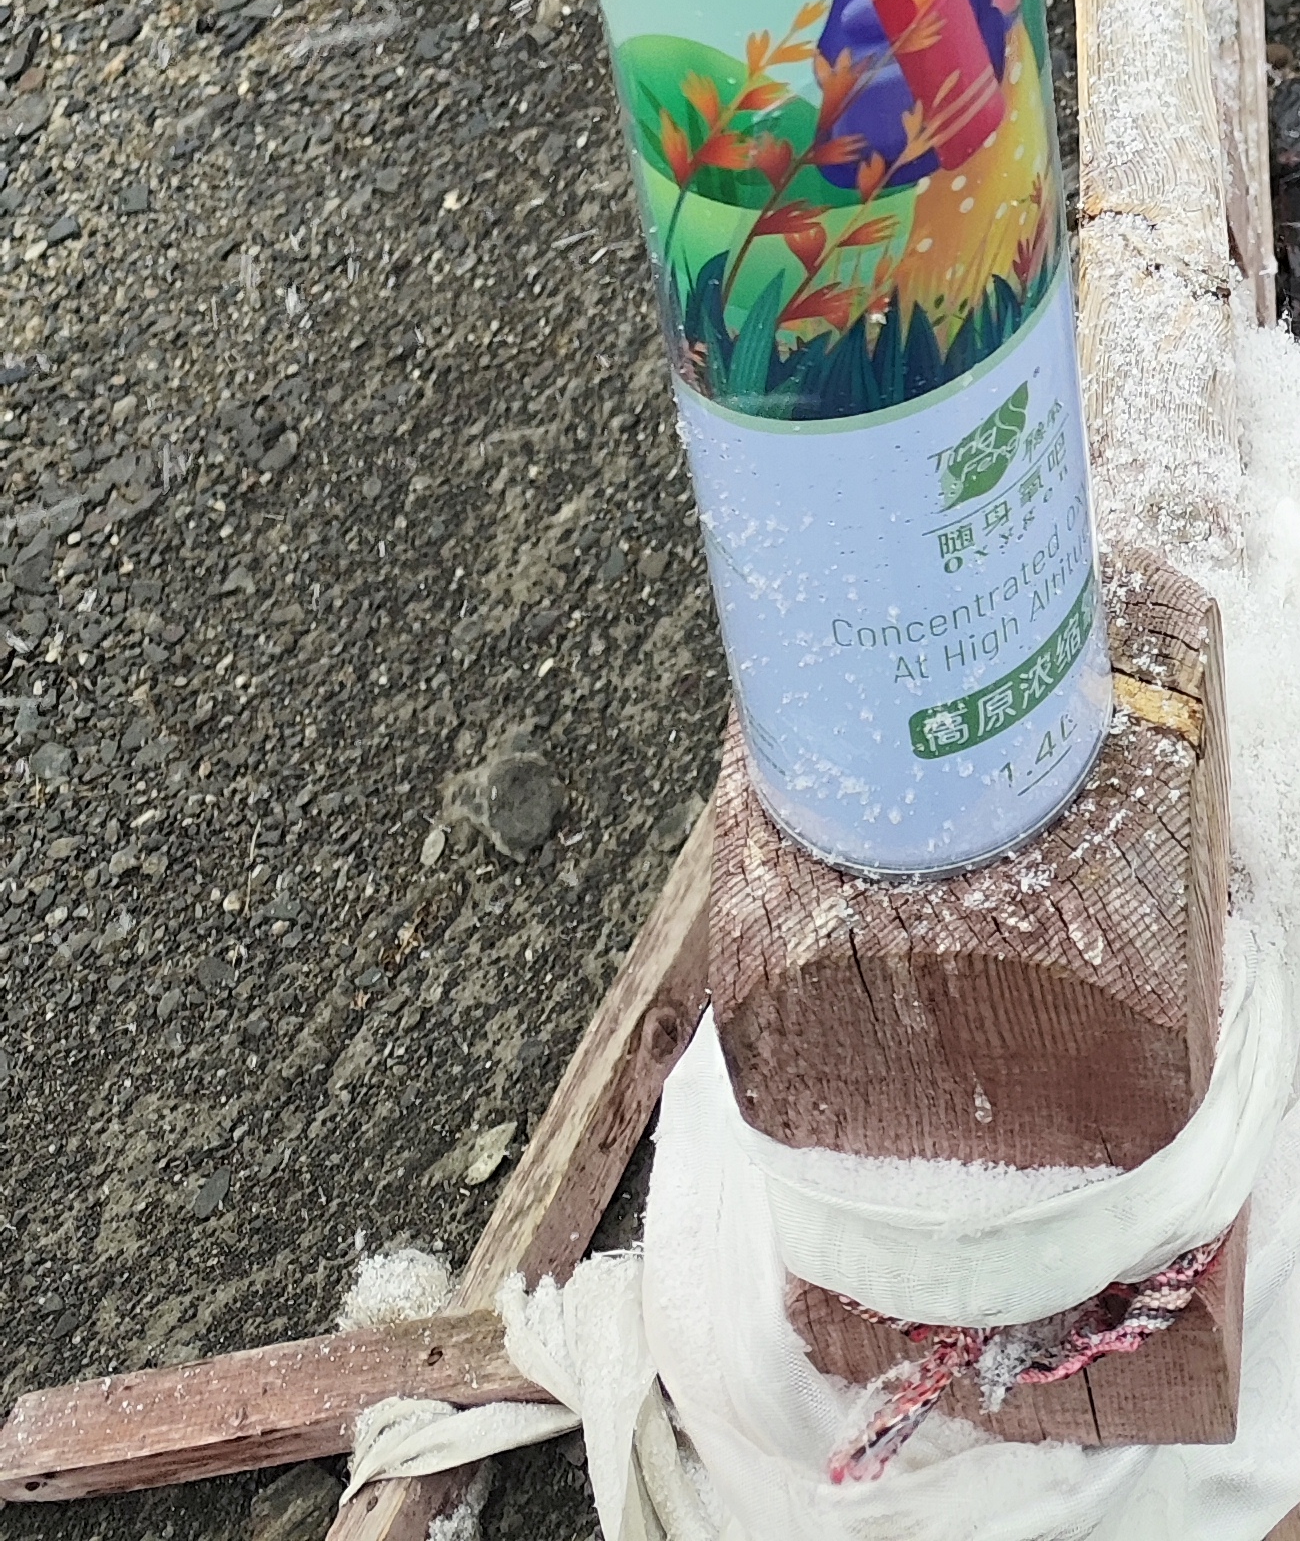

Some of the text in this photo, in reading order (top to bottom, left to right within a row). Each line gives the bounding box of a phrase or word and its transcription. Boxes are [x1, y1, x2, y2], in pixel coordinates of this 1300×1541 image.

[937, 431, 1067, 558] 随身氧吧
[832, 523, 1060, 648] Concentrated
[894, 655, 930, 684] At
[944, 617, 1019, 672] High
